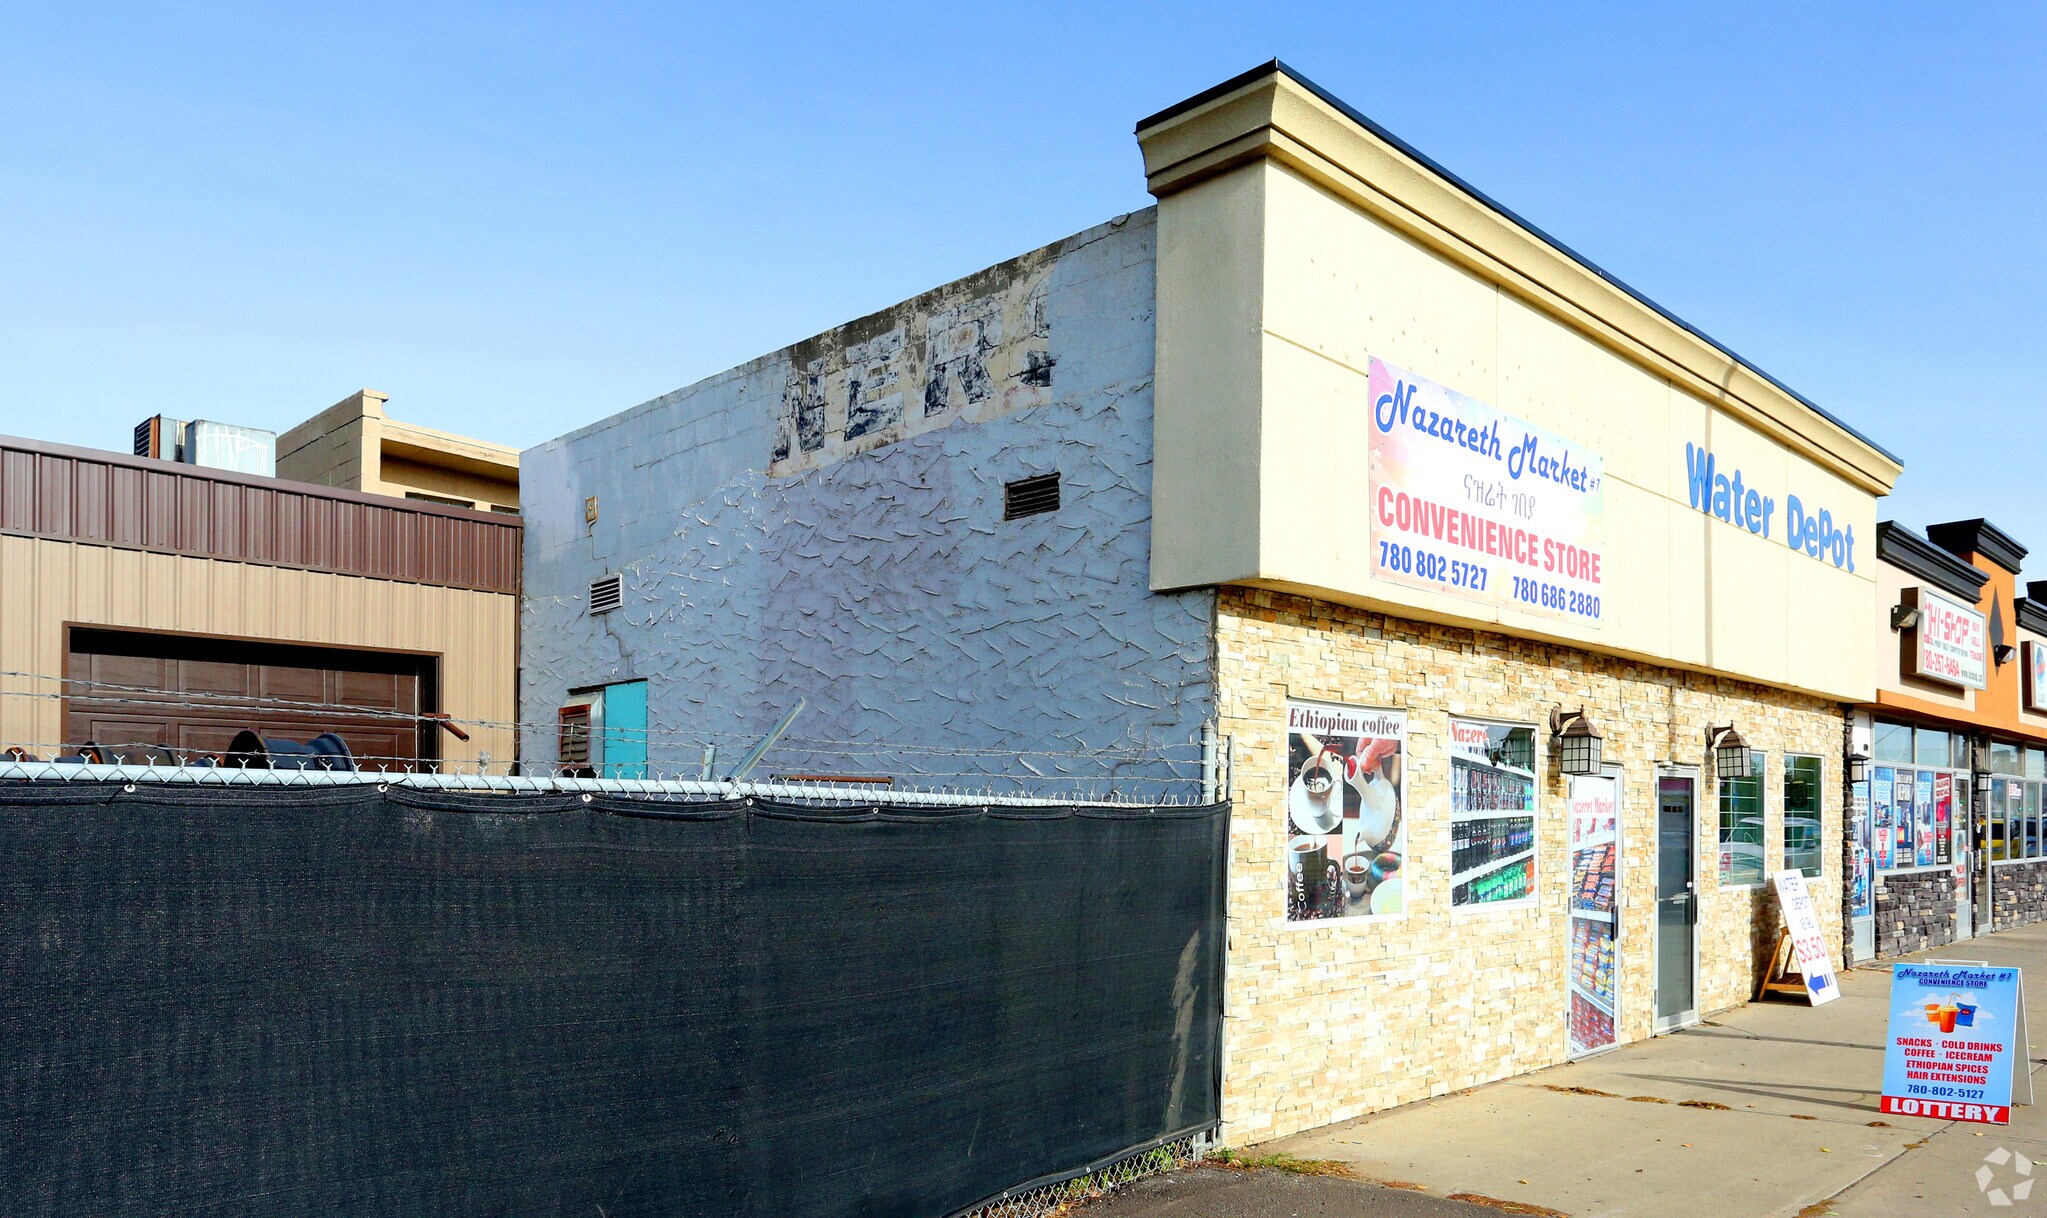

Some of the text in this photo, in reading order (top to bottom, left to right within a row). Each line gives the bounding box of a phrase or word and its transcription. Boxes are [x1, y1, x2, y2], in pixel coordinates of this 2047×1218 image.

[1375, 379, 1502, 460] Nazareth
[1507, 432, 1588, 492] Market
[1686, 441, 1774, 539] Water
[1378, 486, 1601, 584] CONVENIENCE STORE
[1380, 540, 1488, 591] 780 802 5727
[1513, 576, 1600, 619] 780 686 2880
[1289, 707, 1400, 736] Ethiopian coffee
[1295, 862, 1308, 911] Coffee
[1795, 936, 1826, 964] $3.50
[1898, 968, 1950, 978] Nazareth
[1952, 970, 1996, 980] Market
[1919, 978, 1988, 988] CONVENIENCE STORE
[1896, 1037, 2003, 1052] SNACKS COLD DRINKS
[1904, 1048, 1993, 1062] COFFEE ICECREAM
[1906, 1060, 1989, 1074] ETHIOPIAN SPICES
[1907, 1070, 1986, 1085] HAIR EXTENSIONS
[1907, 1084, 1984, 1099] 780-802-5127
[1890, 1097, 2000, 1123] LOTTERY
